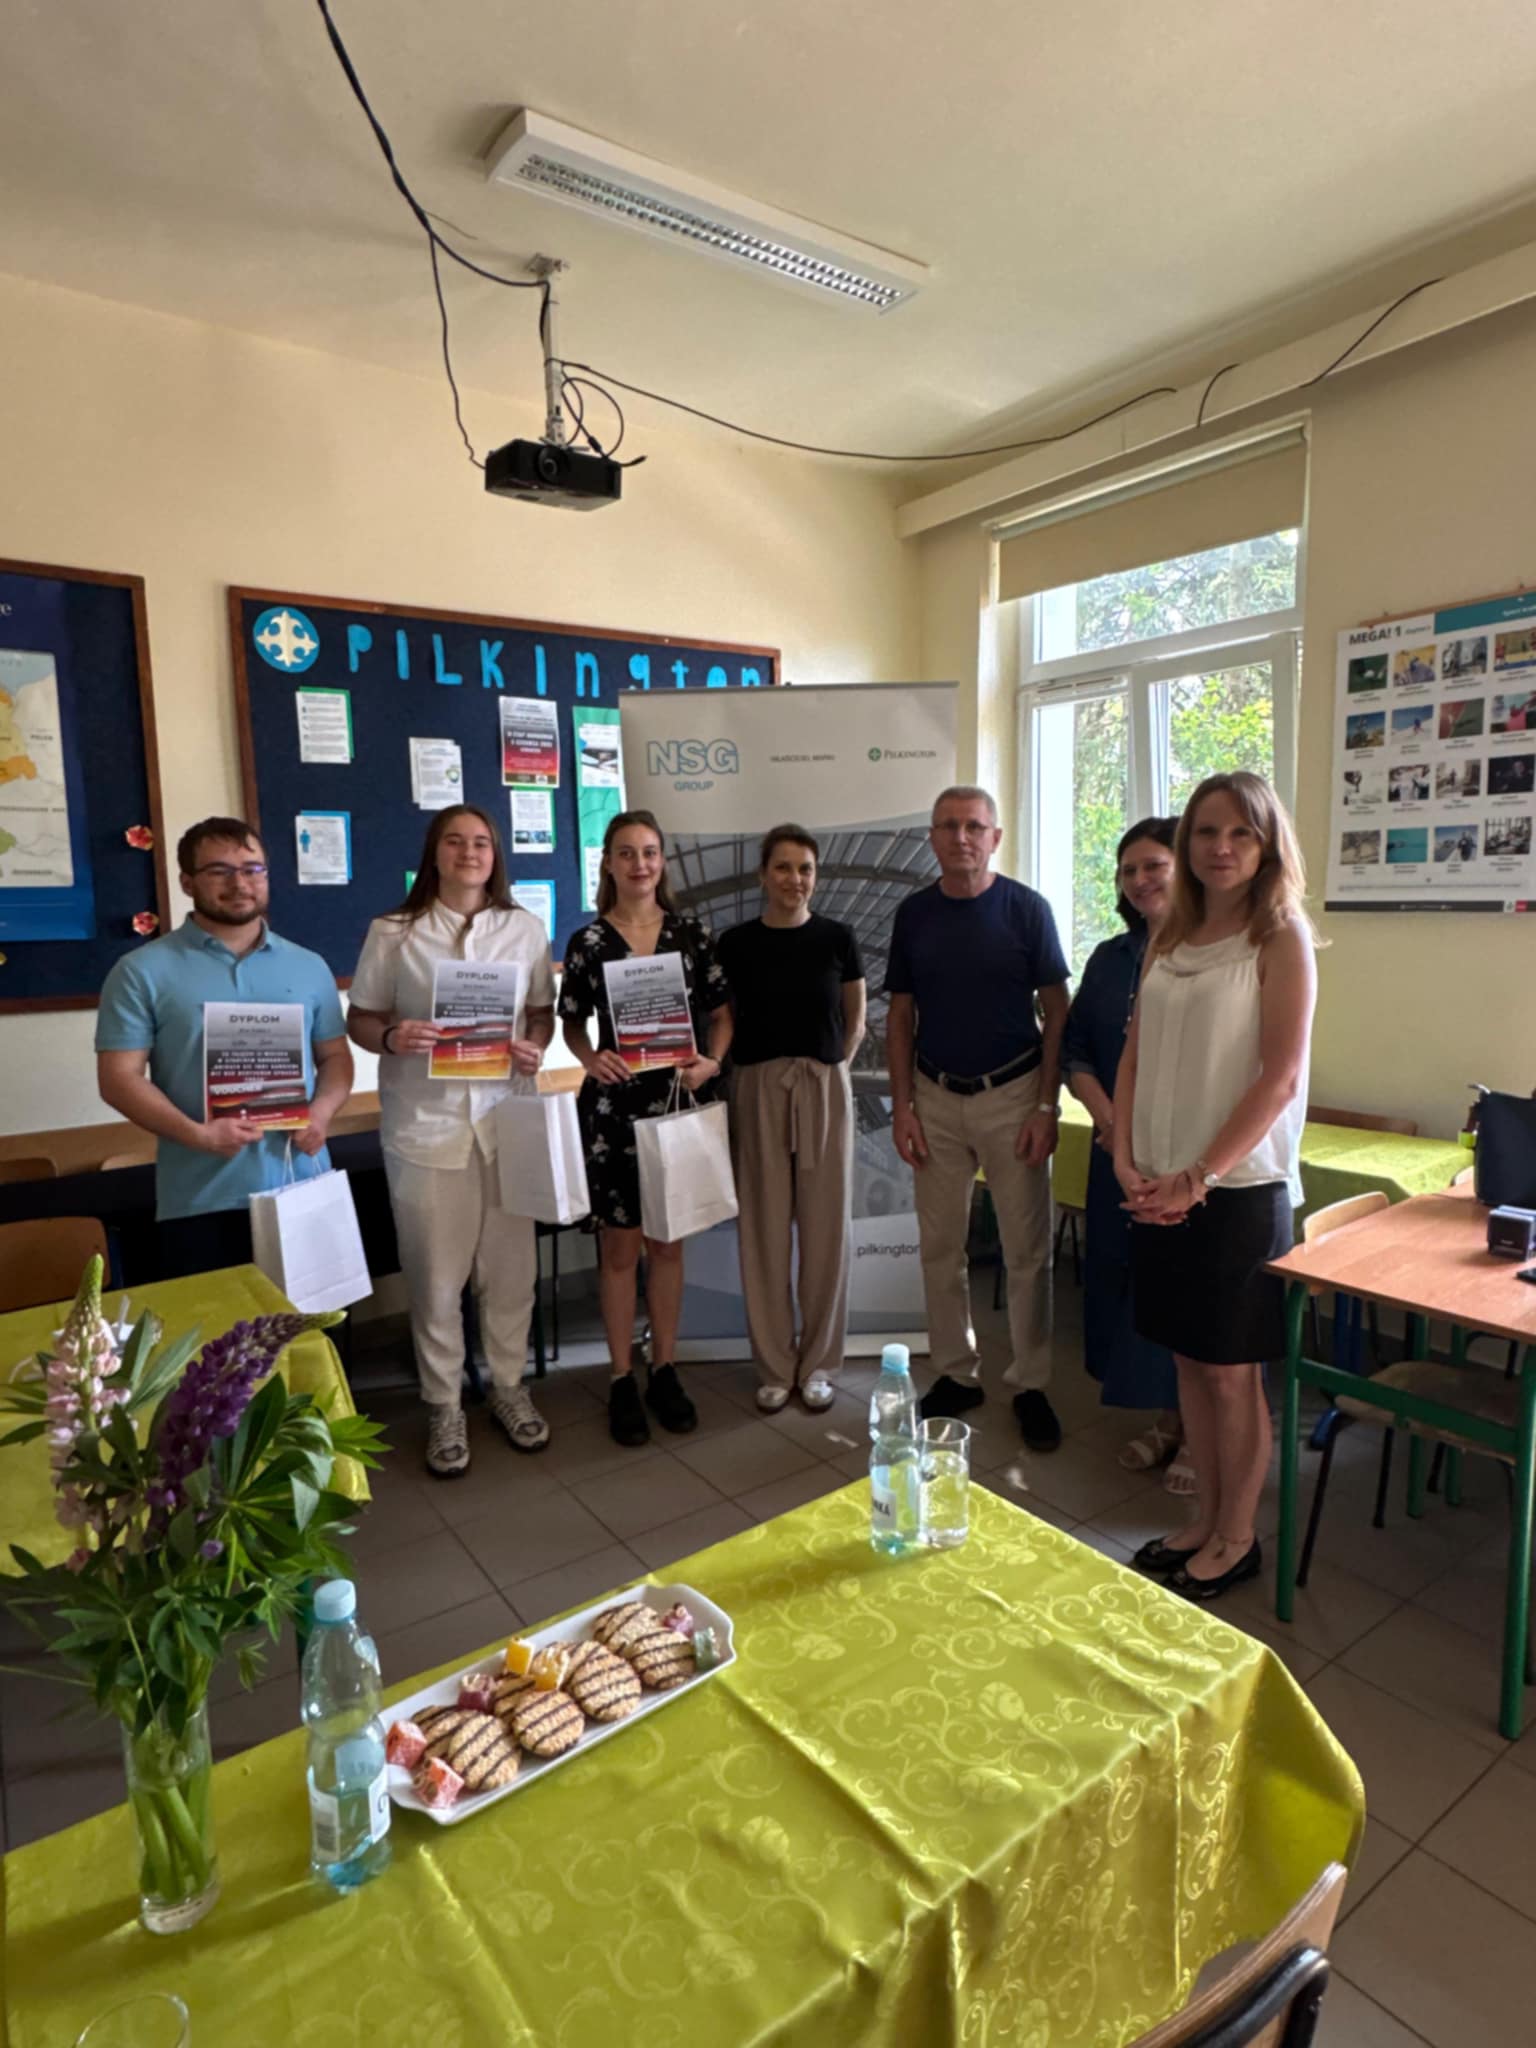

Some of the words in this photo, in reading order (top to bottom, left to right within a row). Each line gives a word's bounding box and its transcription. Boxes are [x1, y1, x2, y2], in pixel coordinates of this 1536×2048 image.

[1349, 628, 1391, 645] MEGA!
[1395, 625, 1402, 637] 1
[647, 738, 739, 776] NSG
[674, 780, 714, 791] GROUP
[456, 970, 499, 981] DYPLOM
[624, 964, 664, 977] DYPLOM
[229, 1014, 280, 1024] DYPLOM
